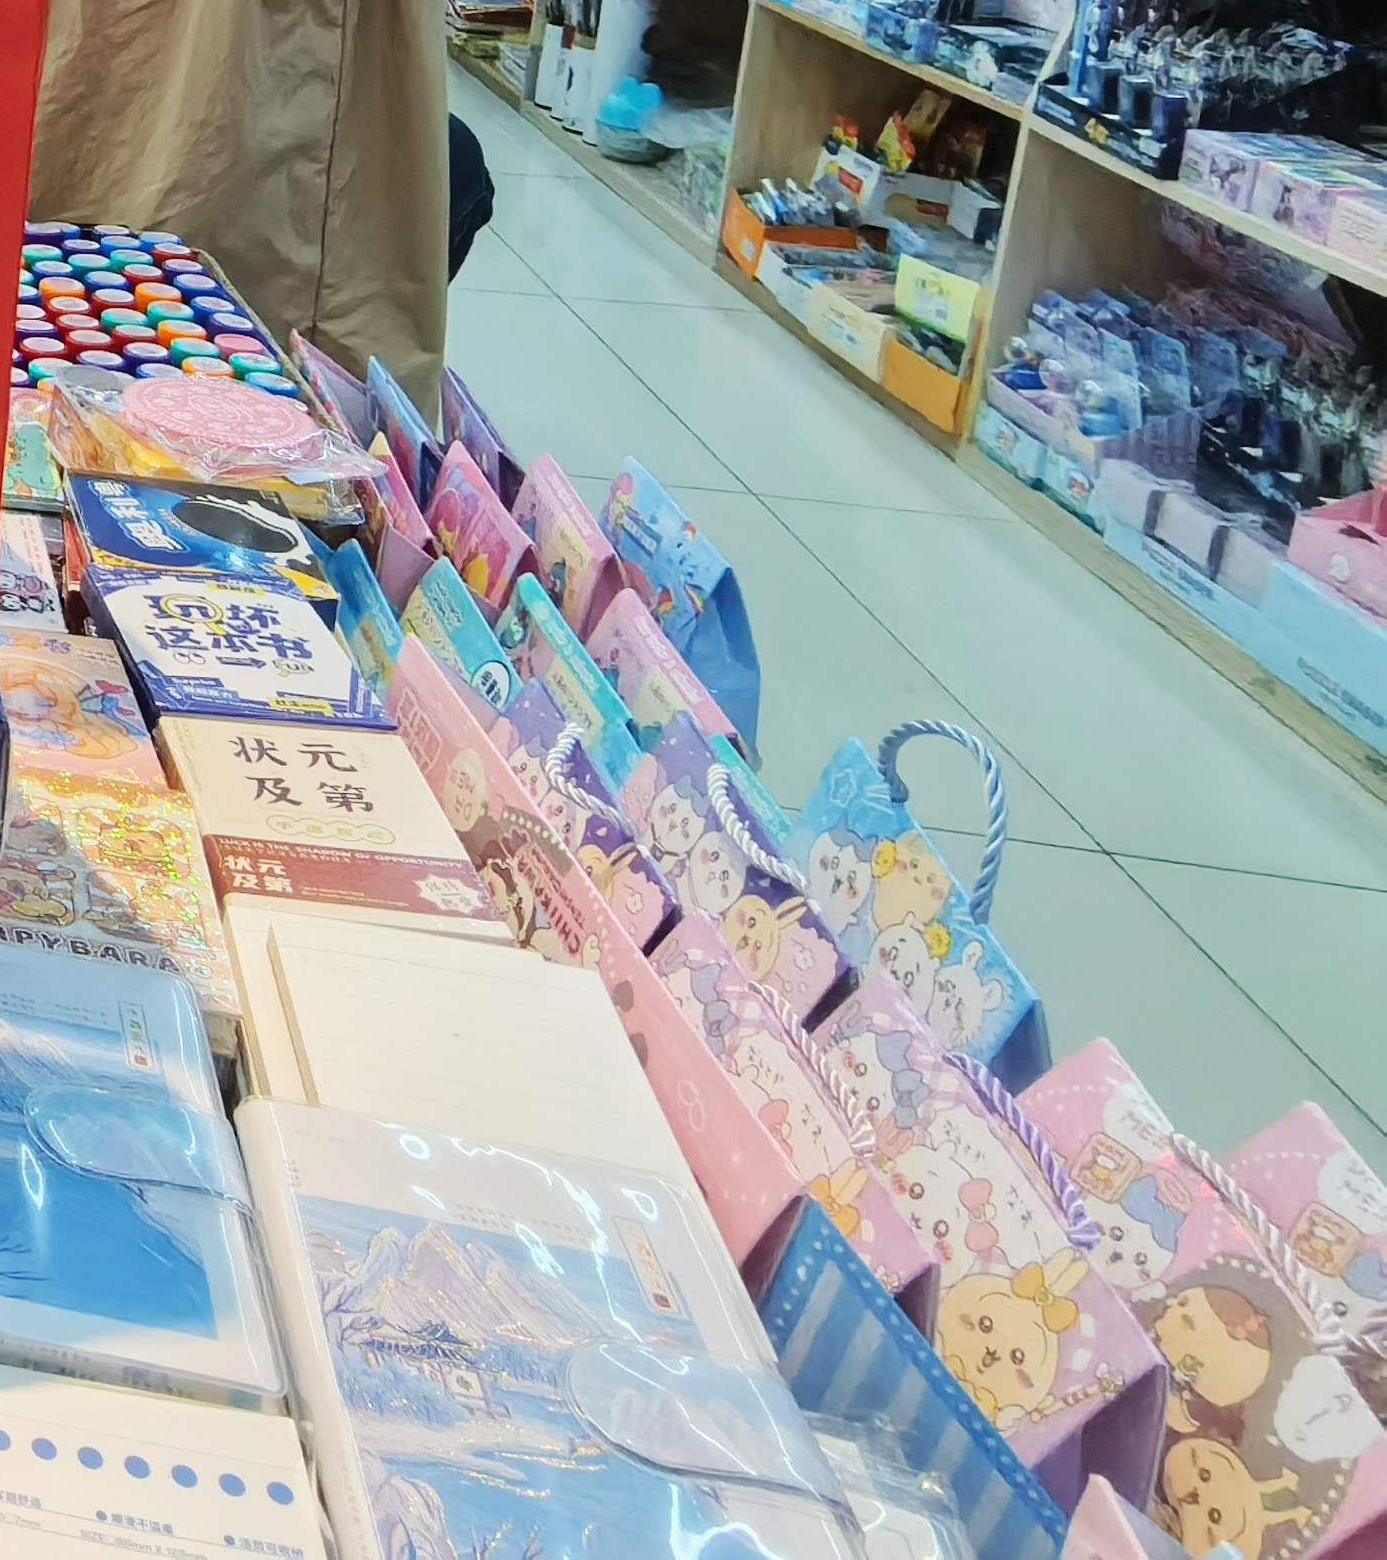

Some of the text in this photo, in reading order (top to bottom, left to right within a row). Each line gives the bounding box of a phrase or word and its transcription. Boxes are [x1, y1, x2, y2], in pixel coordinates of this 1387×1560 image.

[228, 735, 359, 773] 状元
[244, 775, 375, 813] 及第
[223, 854, 288, 877] 状元
[373, 853, 464, 870] OPPORTUNITY
